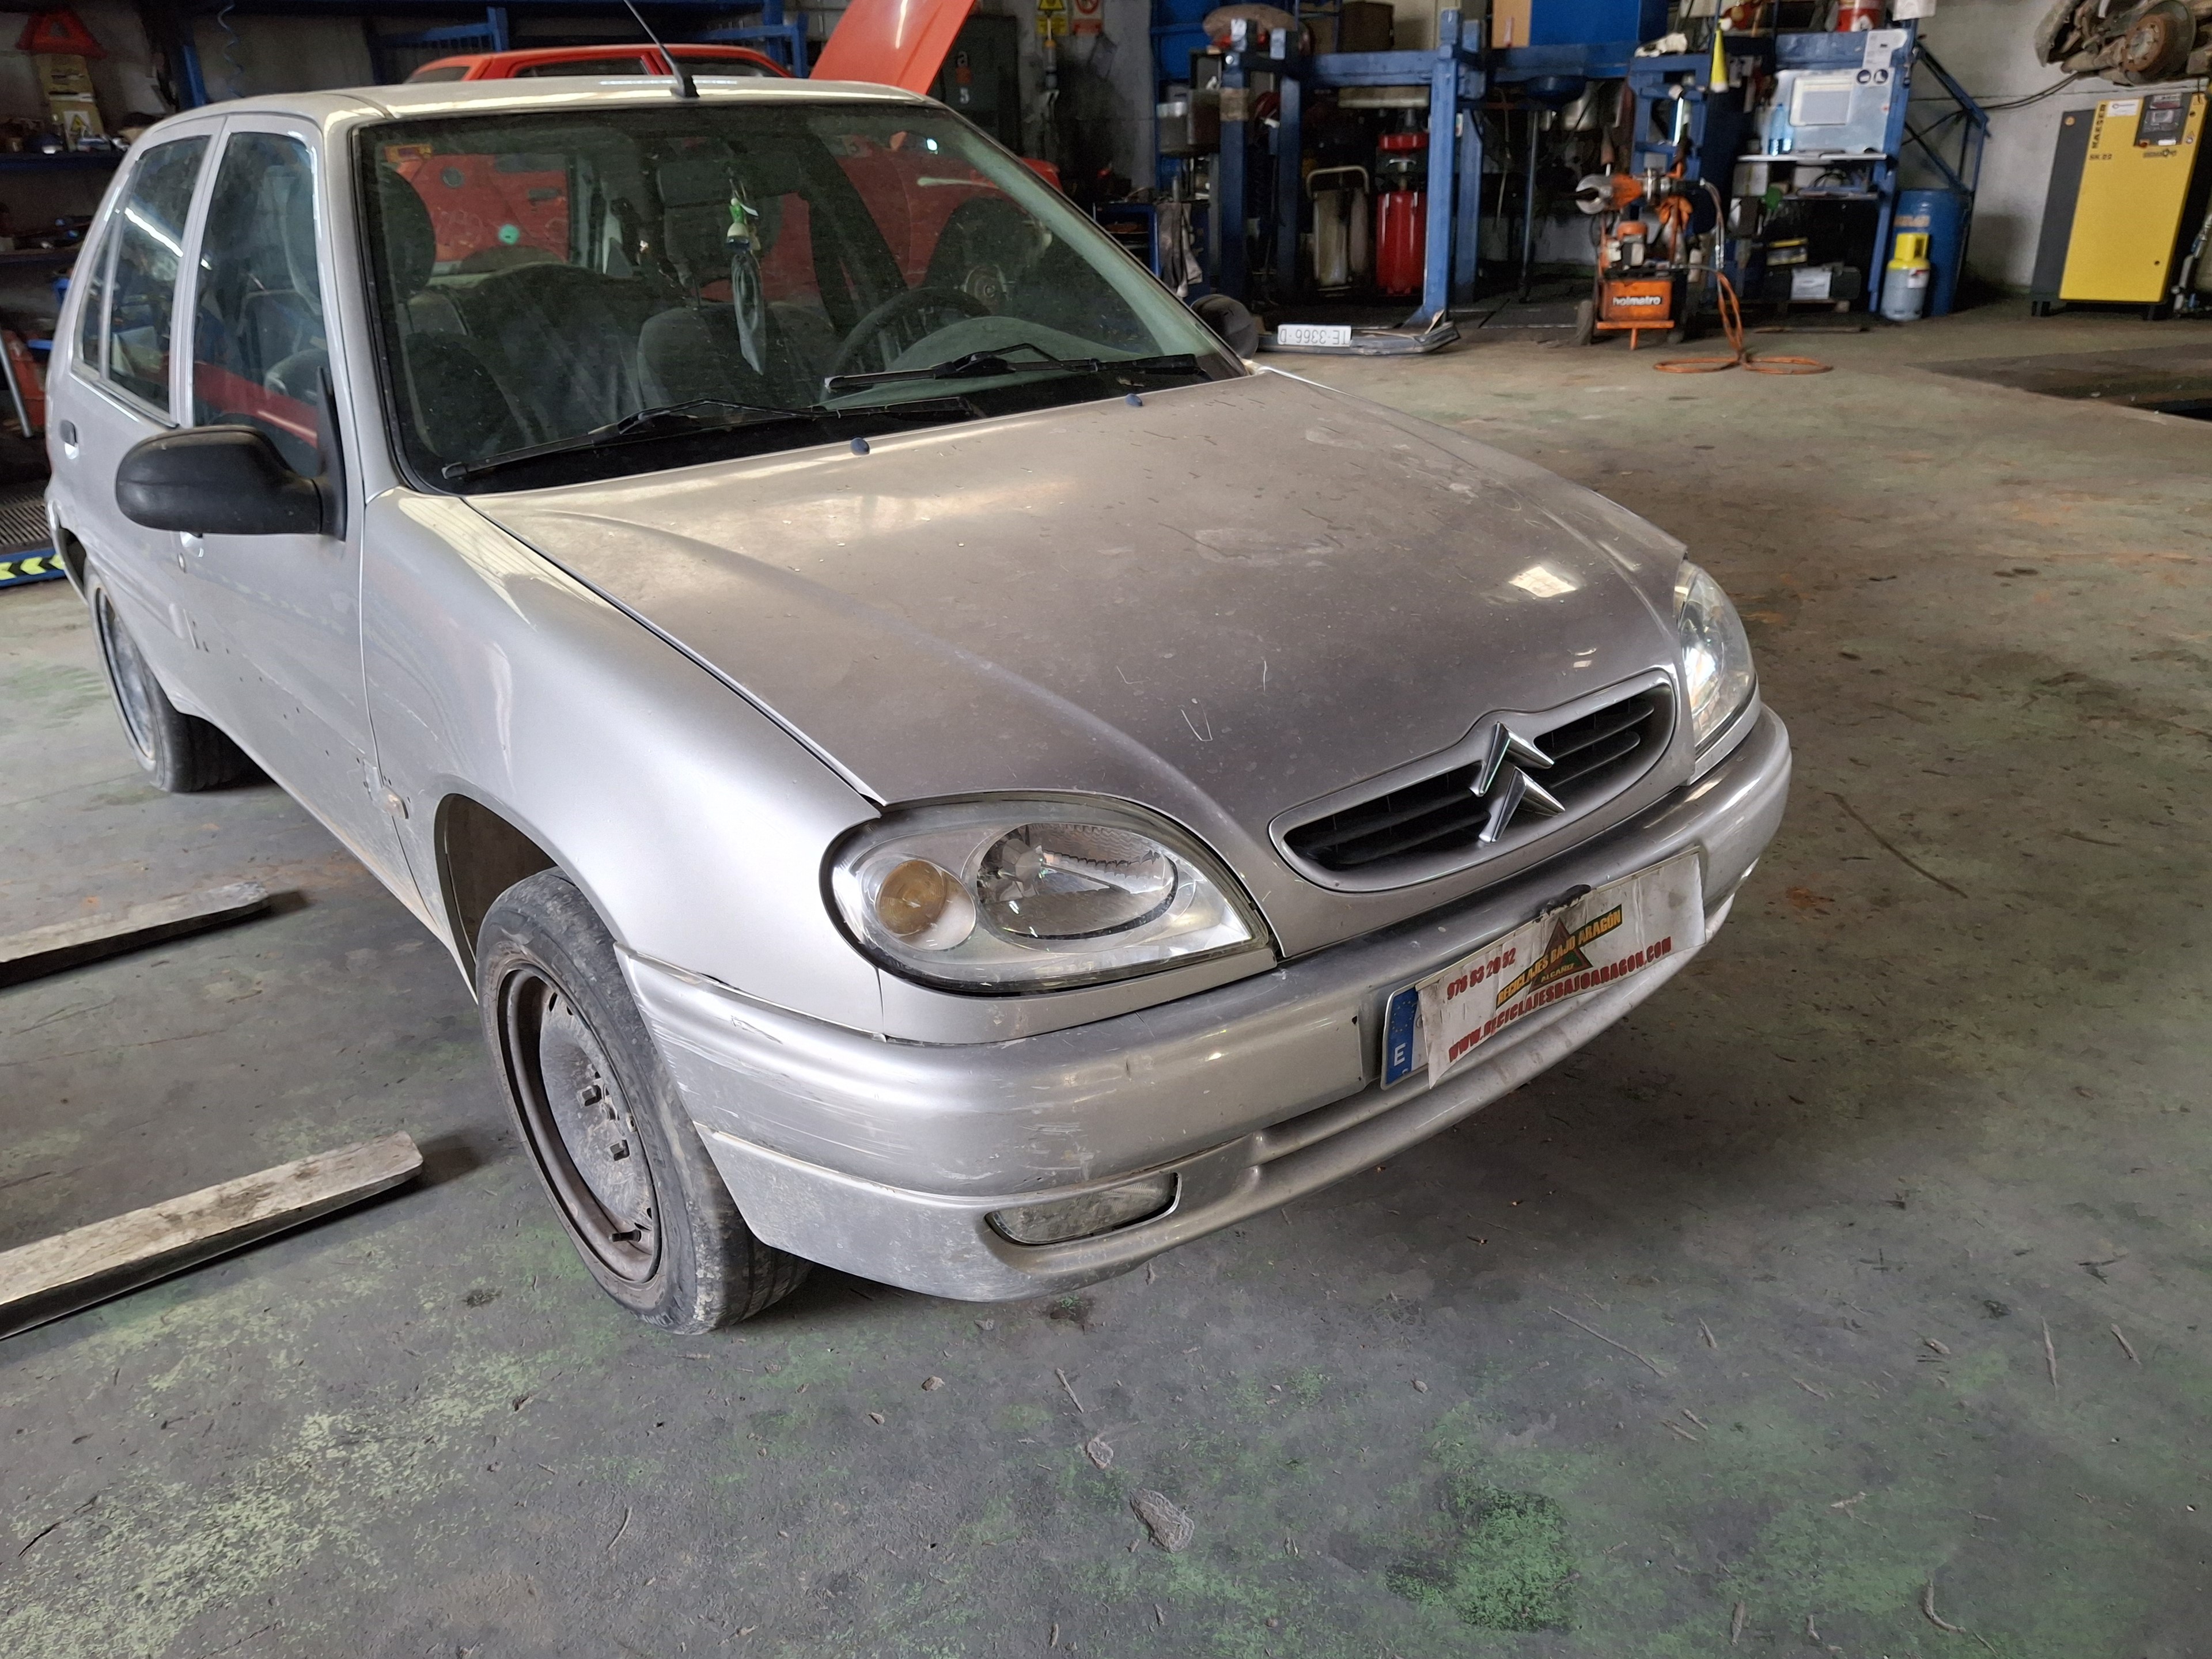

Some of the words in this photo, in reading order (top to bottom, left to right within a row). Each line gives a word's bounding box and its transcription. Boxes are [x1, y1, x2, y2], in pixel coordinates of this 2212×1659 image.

[1613, 296, 1661, 306] holmatro
[1486, 956, 1501, 979] 20
[1502, 947, 1516, 969] 52
[1498, 955, 1548, 1003] RECICLAJES
[1550, 935, 1576, 962] BAJO
[1578, 909, 1621, 946] ARAGÓN
[1540, 963, 1575, 983] ALCAÑIZ
[1448, 936, 1672, 1063] WWW.RECICLAJESBAJOARAGON.COM
[1393, 1042, 1407, 1066] E
